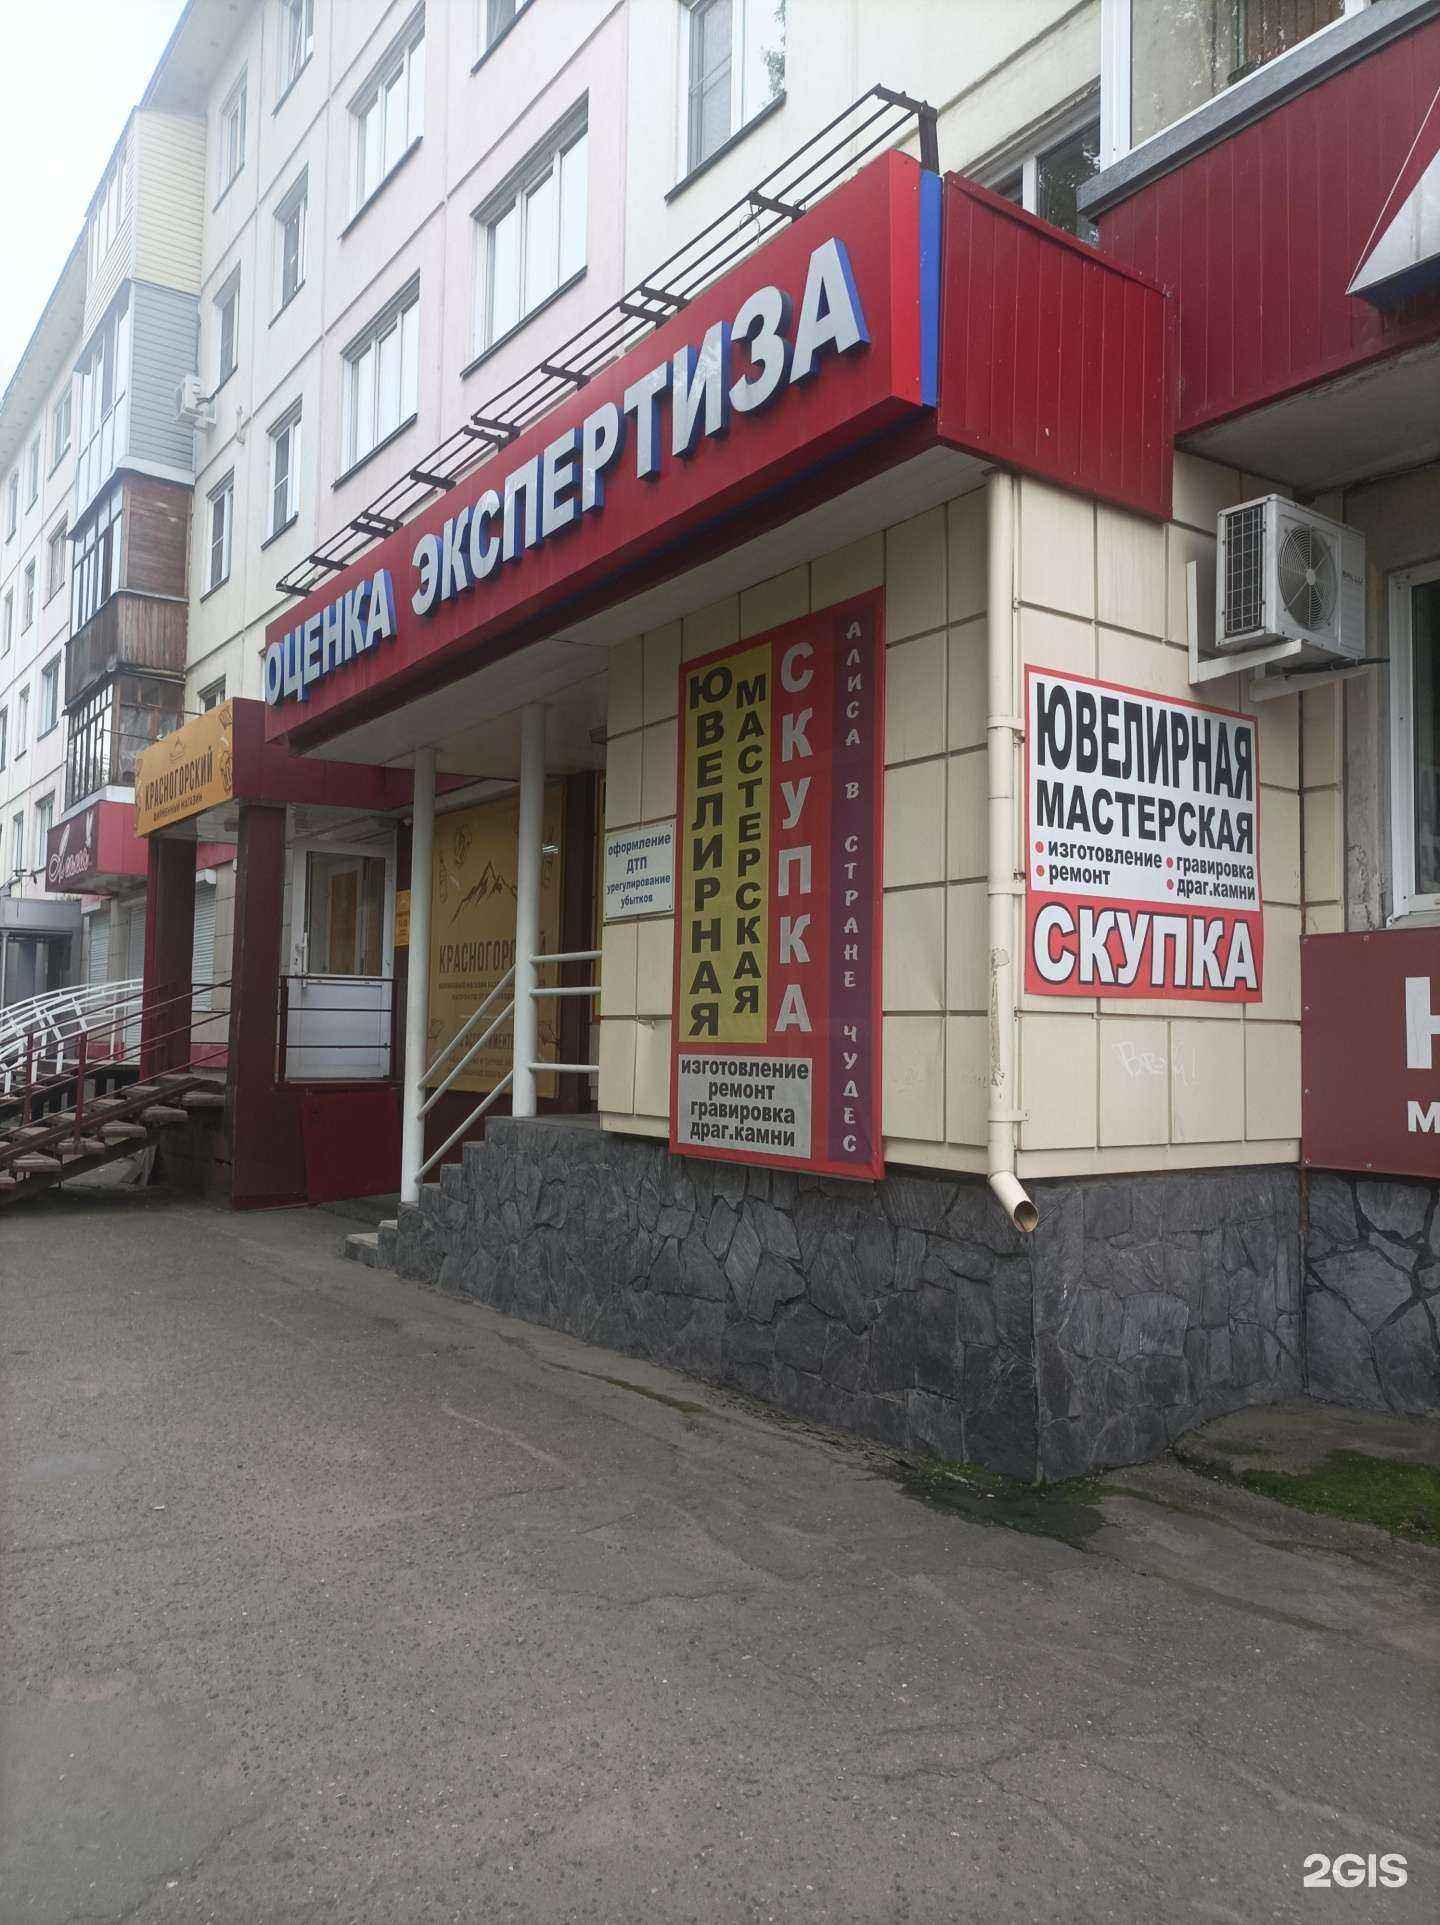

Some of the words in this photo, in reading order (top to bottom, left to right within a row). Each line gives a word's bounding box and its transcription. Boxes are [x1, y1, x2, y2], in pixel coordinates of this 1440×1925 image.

[265, 569, 396, 705] ОЦЕНКА
[411, 236, 870, 616] ЭКСПЕРТИЗА
[845, 621, 863, 746] АЛИСА
[1036, 682, 1253, 802] ЮВЕЛИРНАЯ
[145, 745, 213, 812] КРАСНОГОРСКИЙ
[844, 782, 860, 800] В
[774, 642, 814, 1032] СКУПКА
[1036, 779, 1253, 855] МАСТЕРСКАЯ
[608, 834, 671, 857] оформление
[626, 856, 648, 875] ДТП
[688, 666, 733, 1036] ЮВЕЛИРНАЯ
[732, 673, 766, 1014] МАСТЕРСКАЯ
[1048, 841, 1162, 869] изготовление
[607, 874, 671, 895] урегулирование
[1049, 864, 1110, 886] ремонт
[1176, 856, 1255, 881] гравировка
[620, 893, 653, 909] убытков
[843, 835, 861, 988] СТРАНЕ
[1032, 901, 1259, 991] СКУПКА
[681, 1060, 809, 1080] изготовление
[708, 1081, 775, 1101] ремонт
[842, 1025, 860, 1152] ЧУДЕС
[690, 1101, 796, 1125] гравировка
